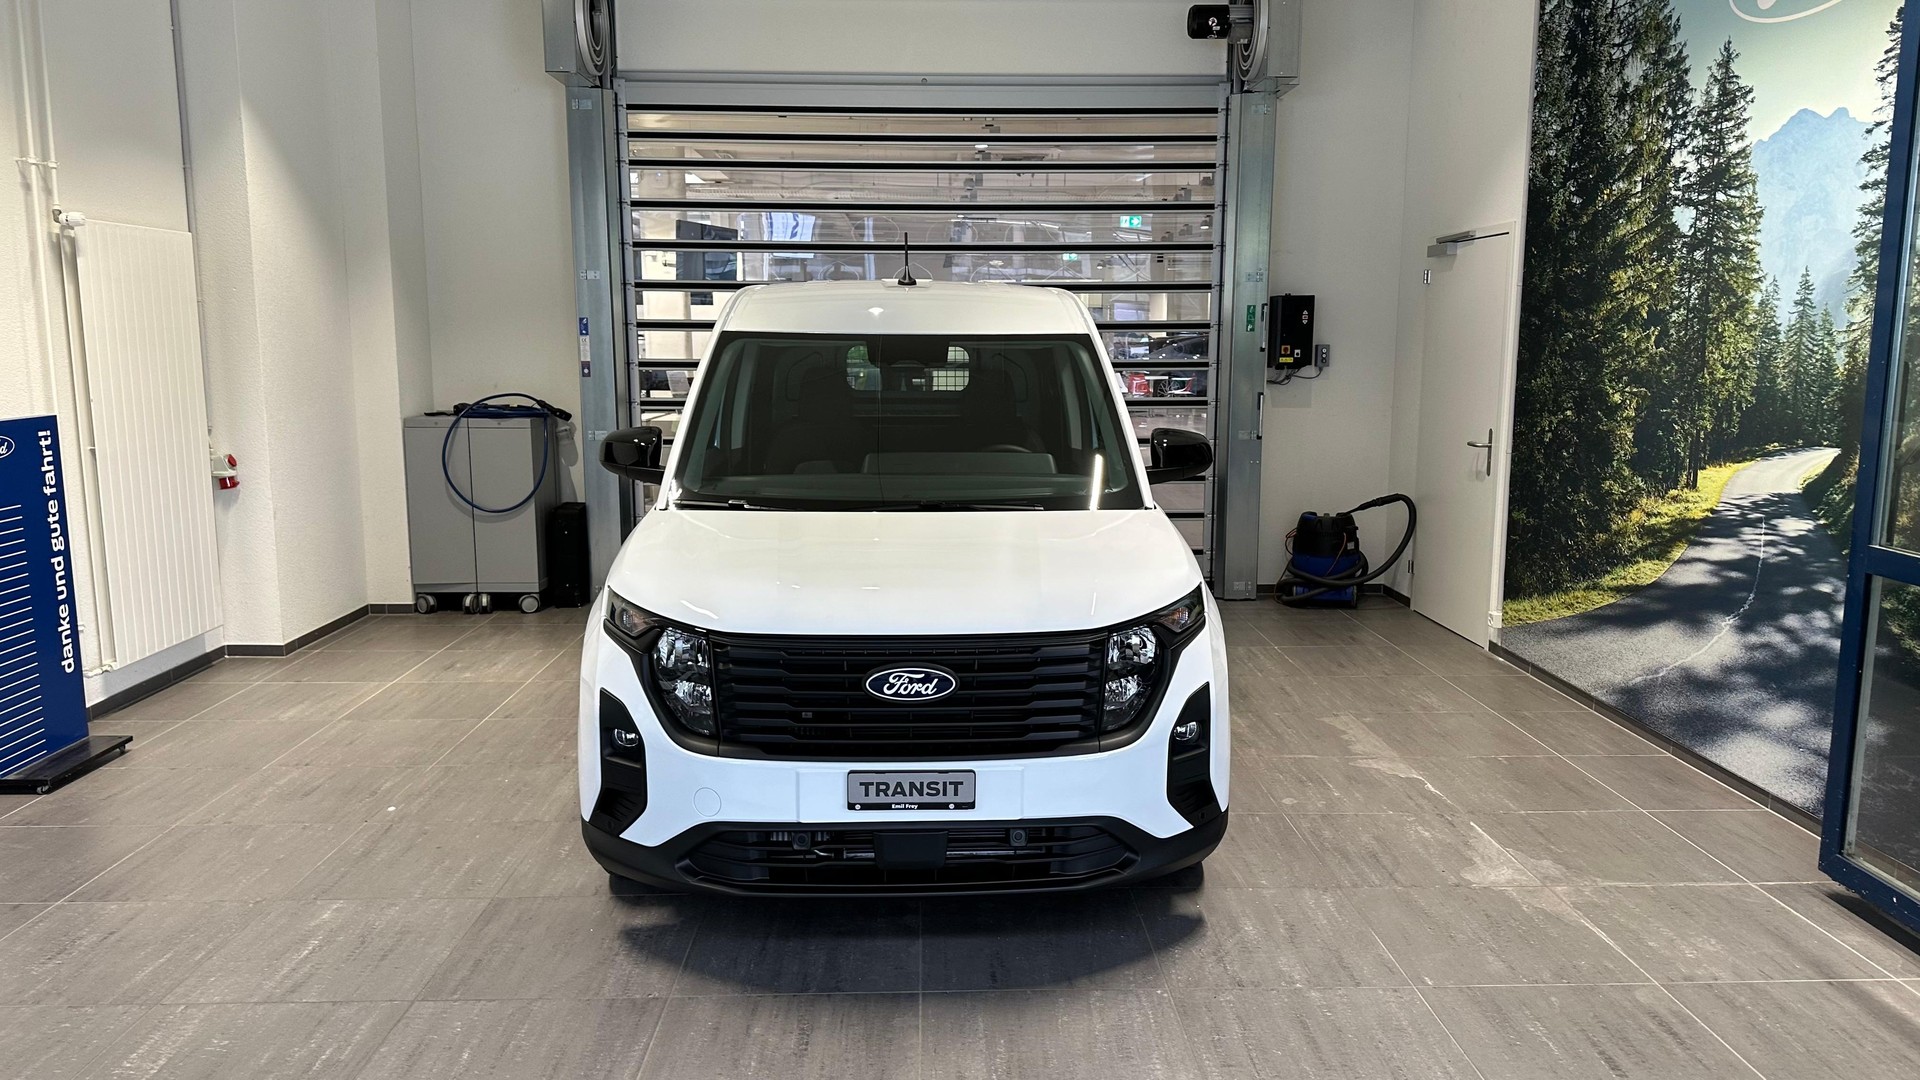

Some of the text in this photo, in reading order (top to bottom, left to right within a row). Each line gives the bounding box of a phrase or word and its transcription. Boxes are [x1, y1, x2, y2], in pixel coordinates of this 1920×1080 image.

[37, 430, 75, 674] danke und gute fahrt!
[883, 672, 938, 695] Ford
[859, 781, 964, 797] TRANSIT
